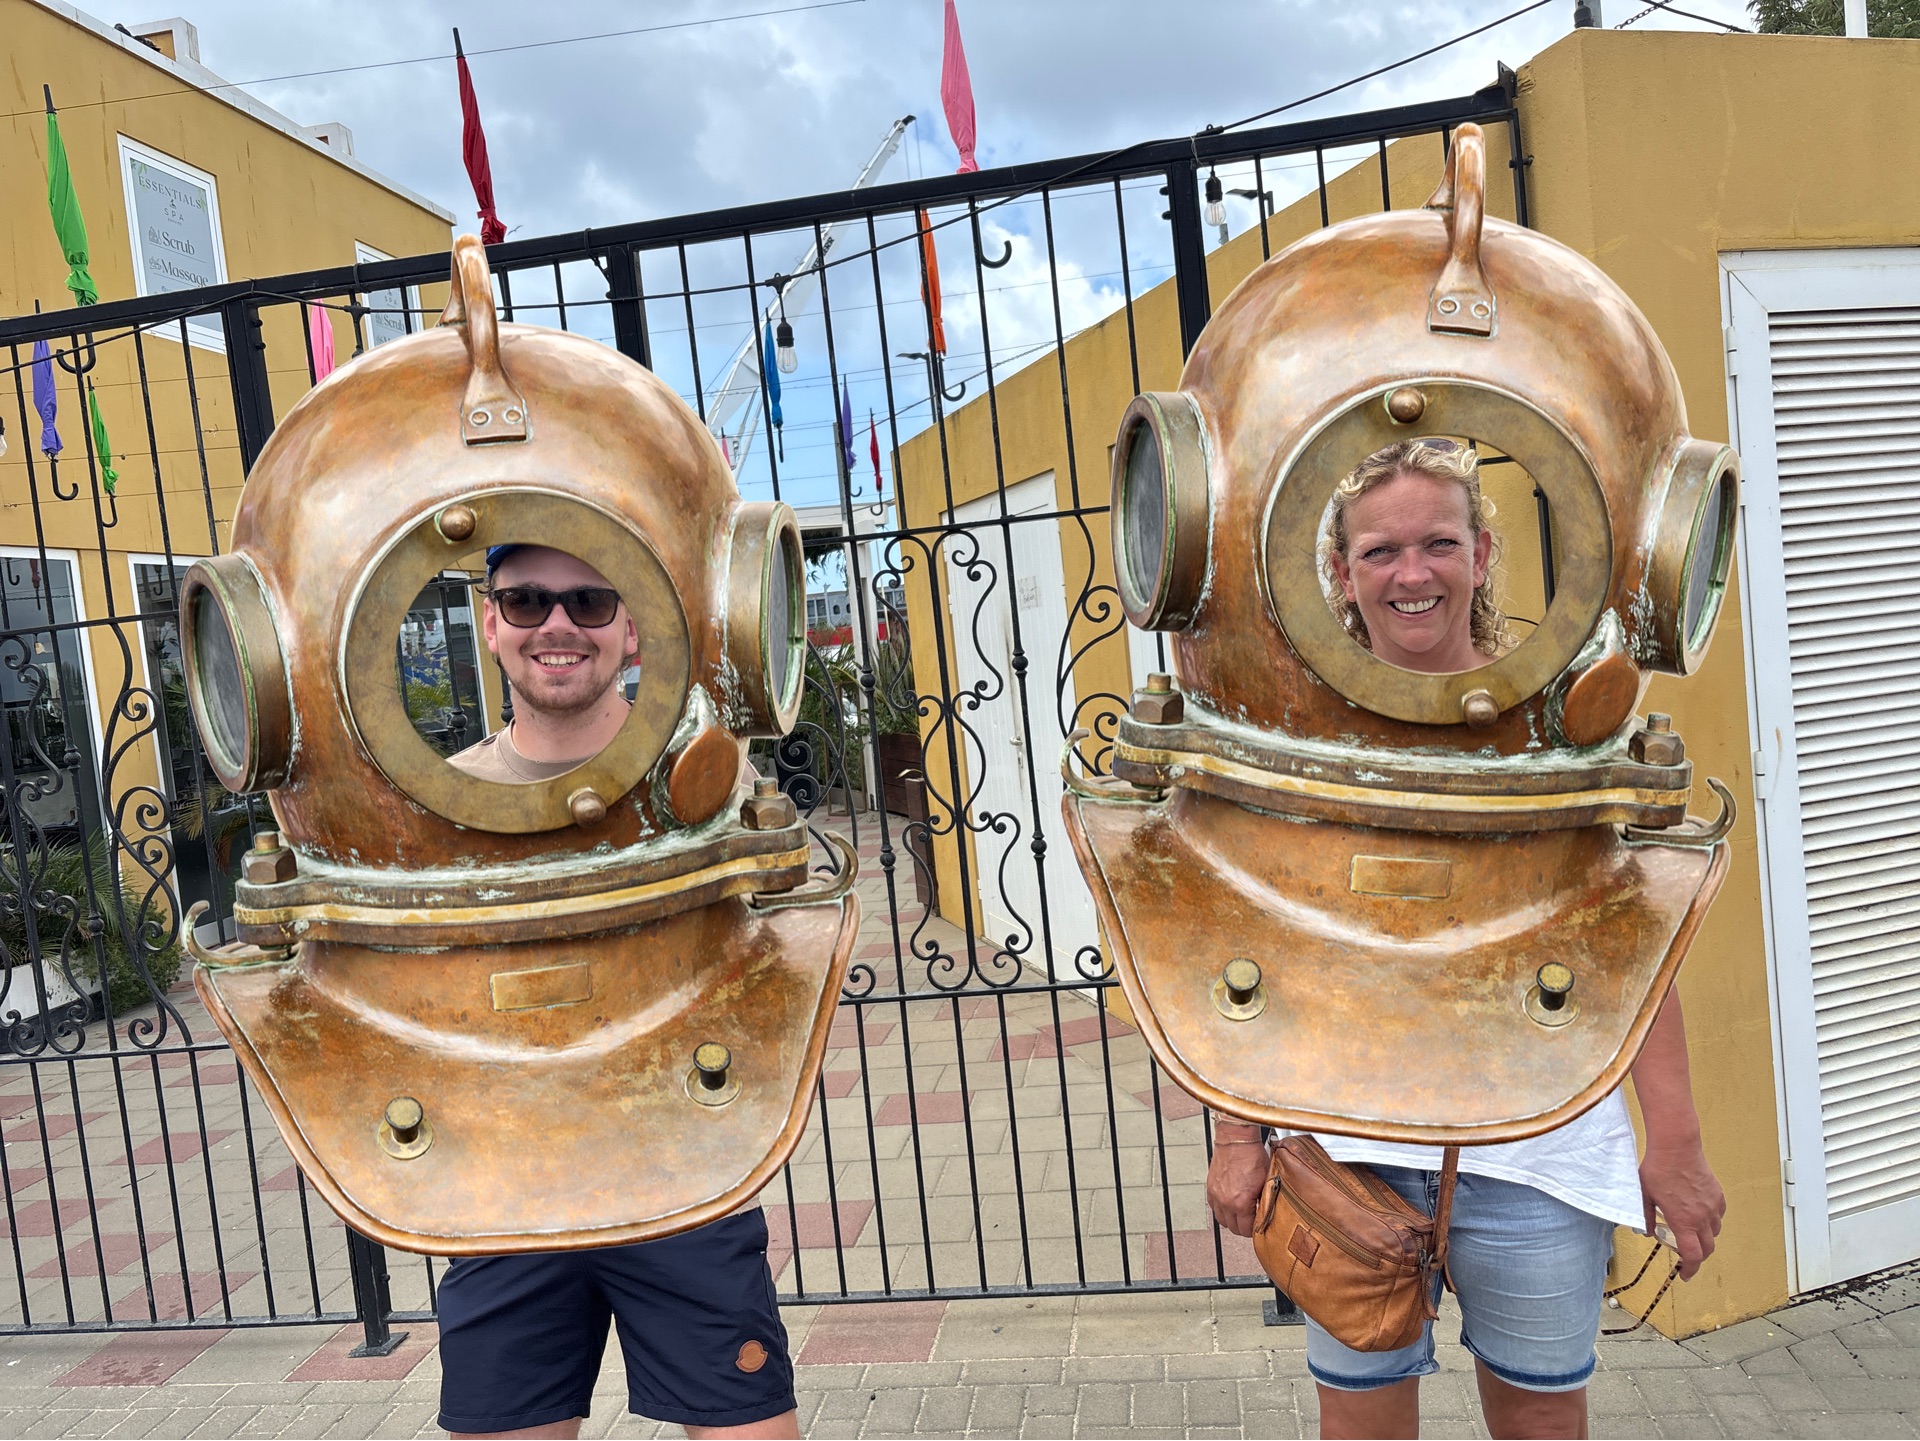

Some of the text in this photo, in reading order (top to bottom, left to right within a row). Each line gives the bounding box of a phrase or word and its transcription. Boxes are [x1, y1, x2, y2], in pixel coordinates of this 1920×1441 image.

[138, 175, 202, 210] ESSENTIALS
[161, 231, 195, 256] Scrub
[161, 258, 209, 288] Massage
[383, 313, 405, 332] Scrub
